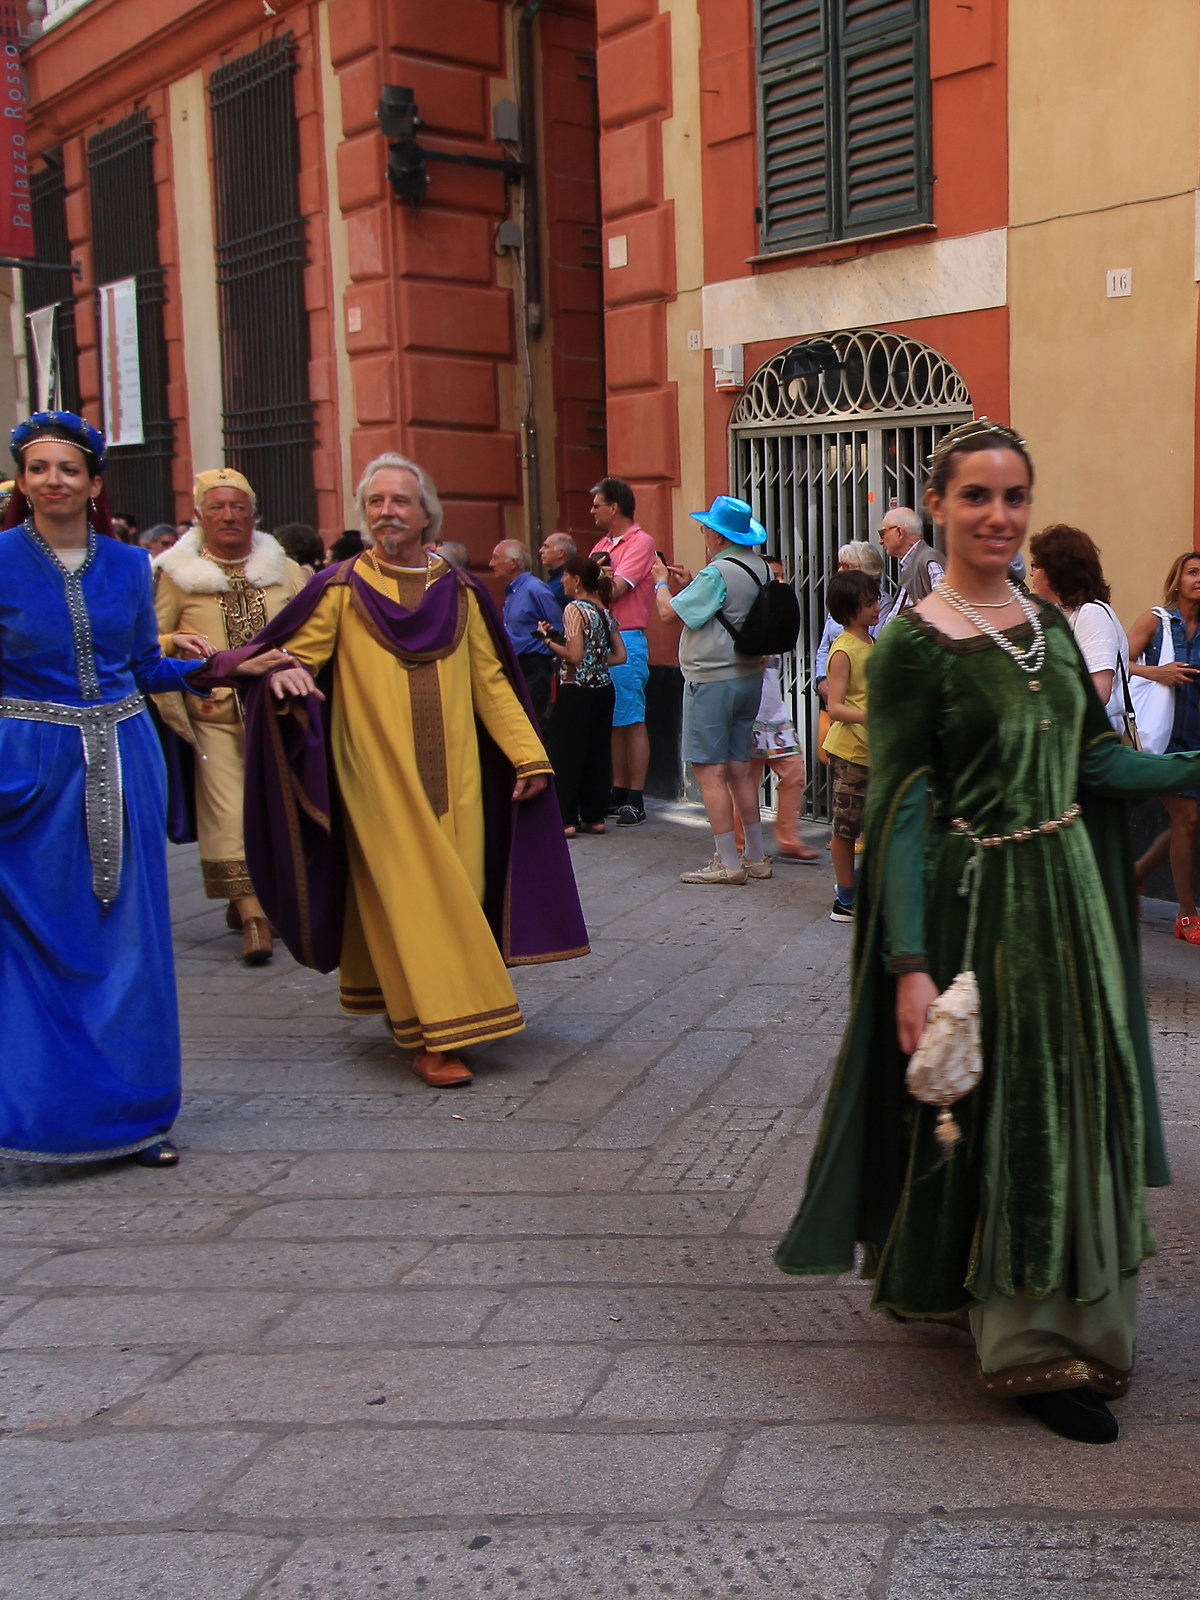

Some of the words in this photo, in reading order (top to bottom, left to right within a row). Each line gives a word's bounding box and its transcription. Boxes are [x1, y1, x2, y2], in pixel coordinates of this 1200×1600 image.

[4, 44, 23, 119] Rosso
[10, 134, 32, 227] Palazzo
[1112, 275, 1127, 292] 16
